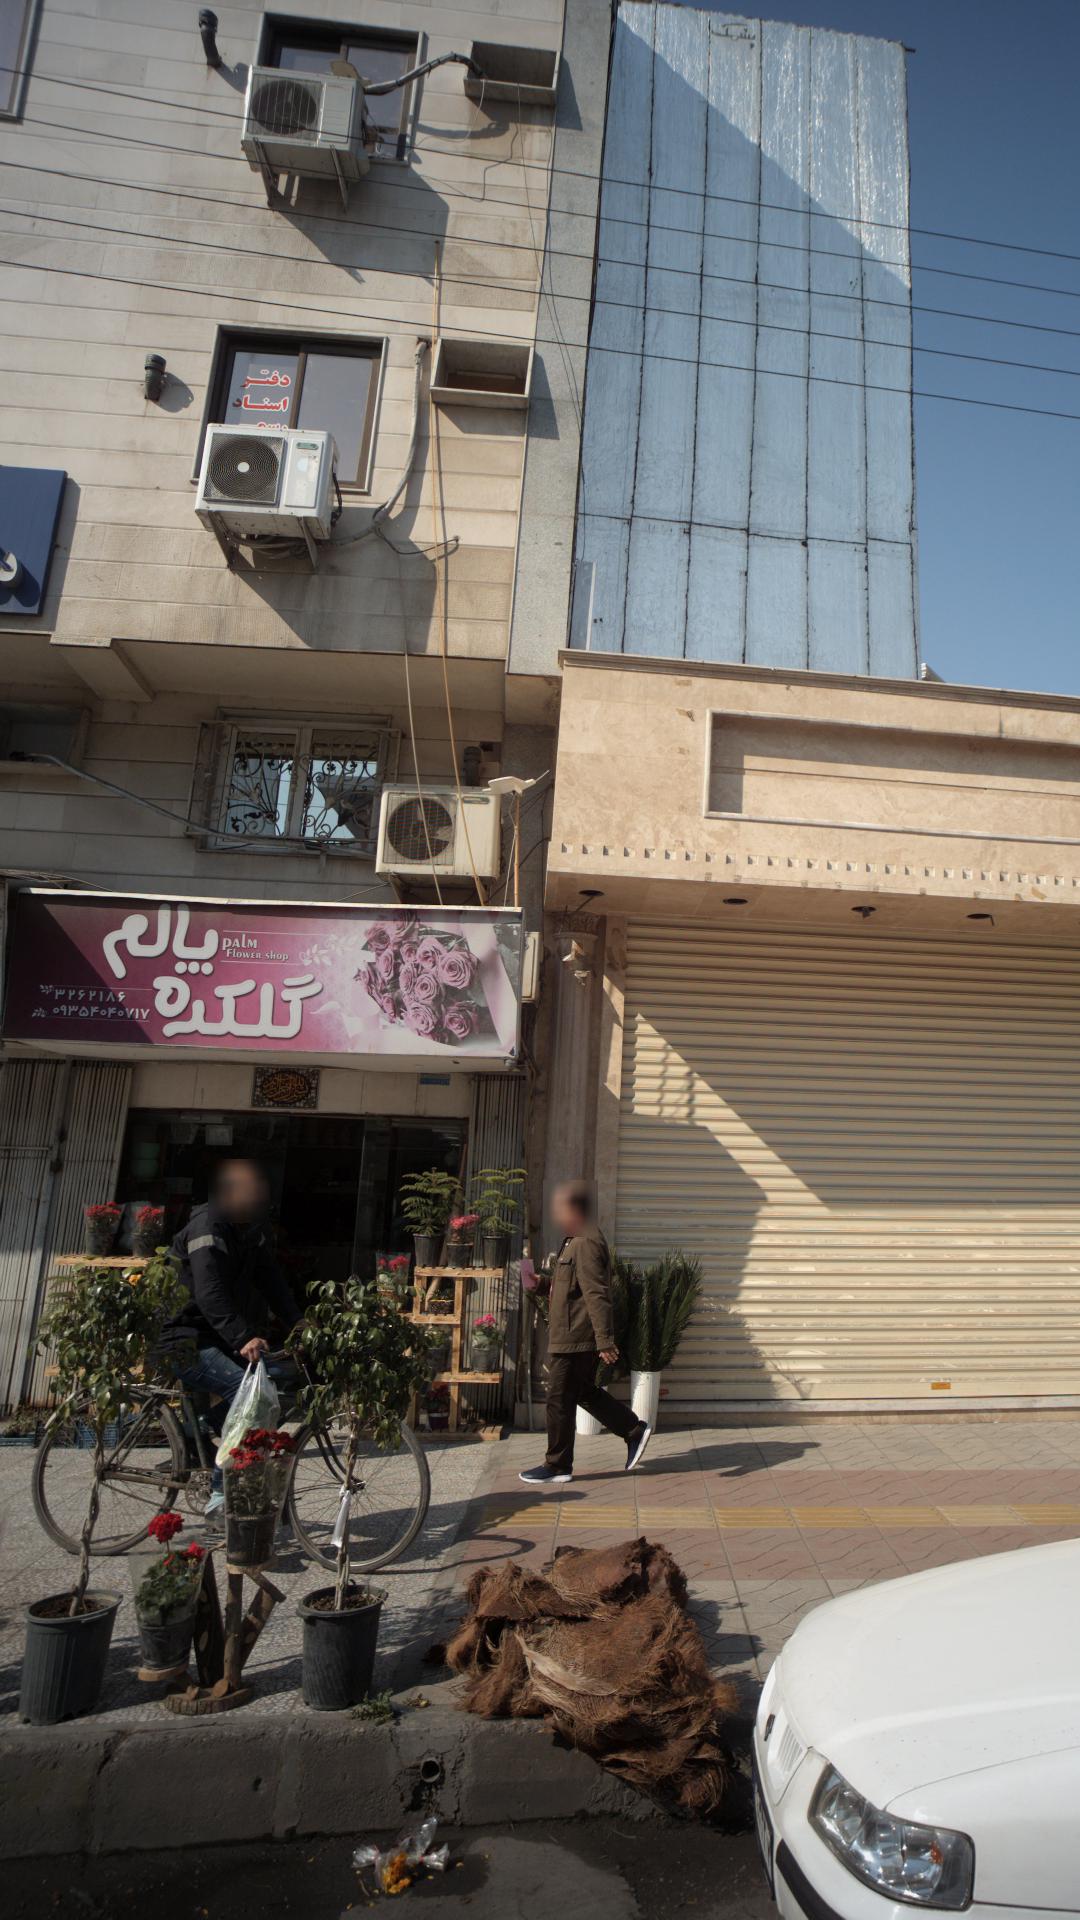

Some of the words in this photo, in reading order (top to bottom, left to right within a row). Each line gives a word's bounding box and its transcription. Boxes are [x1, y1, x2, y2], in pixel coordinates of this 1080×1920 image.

[240, 369, 291, 388] دفتر
[232, 394, 289, 412] اسناد
[102, 903, 219, 979] پالم
[152, 974, 324, 1039] گلکده
